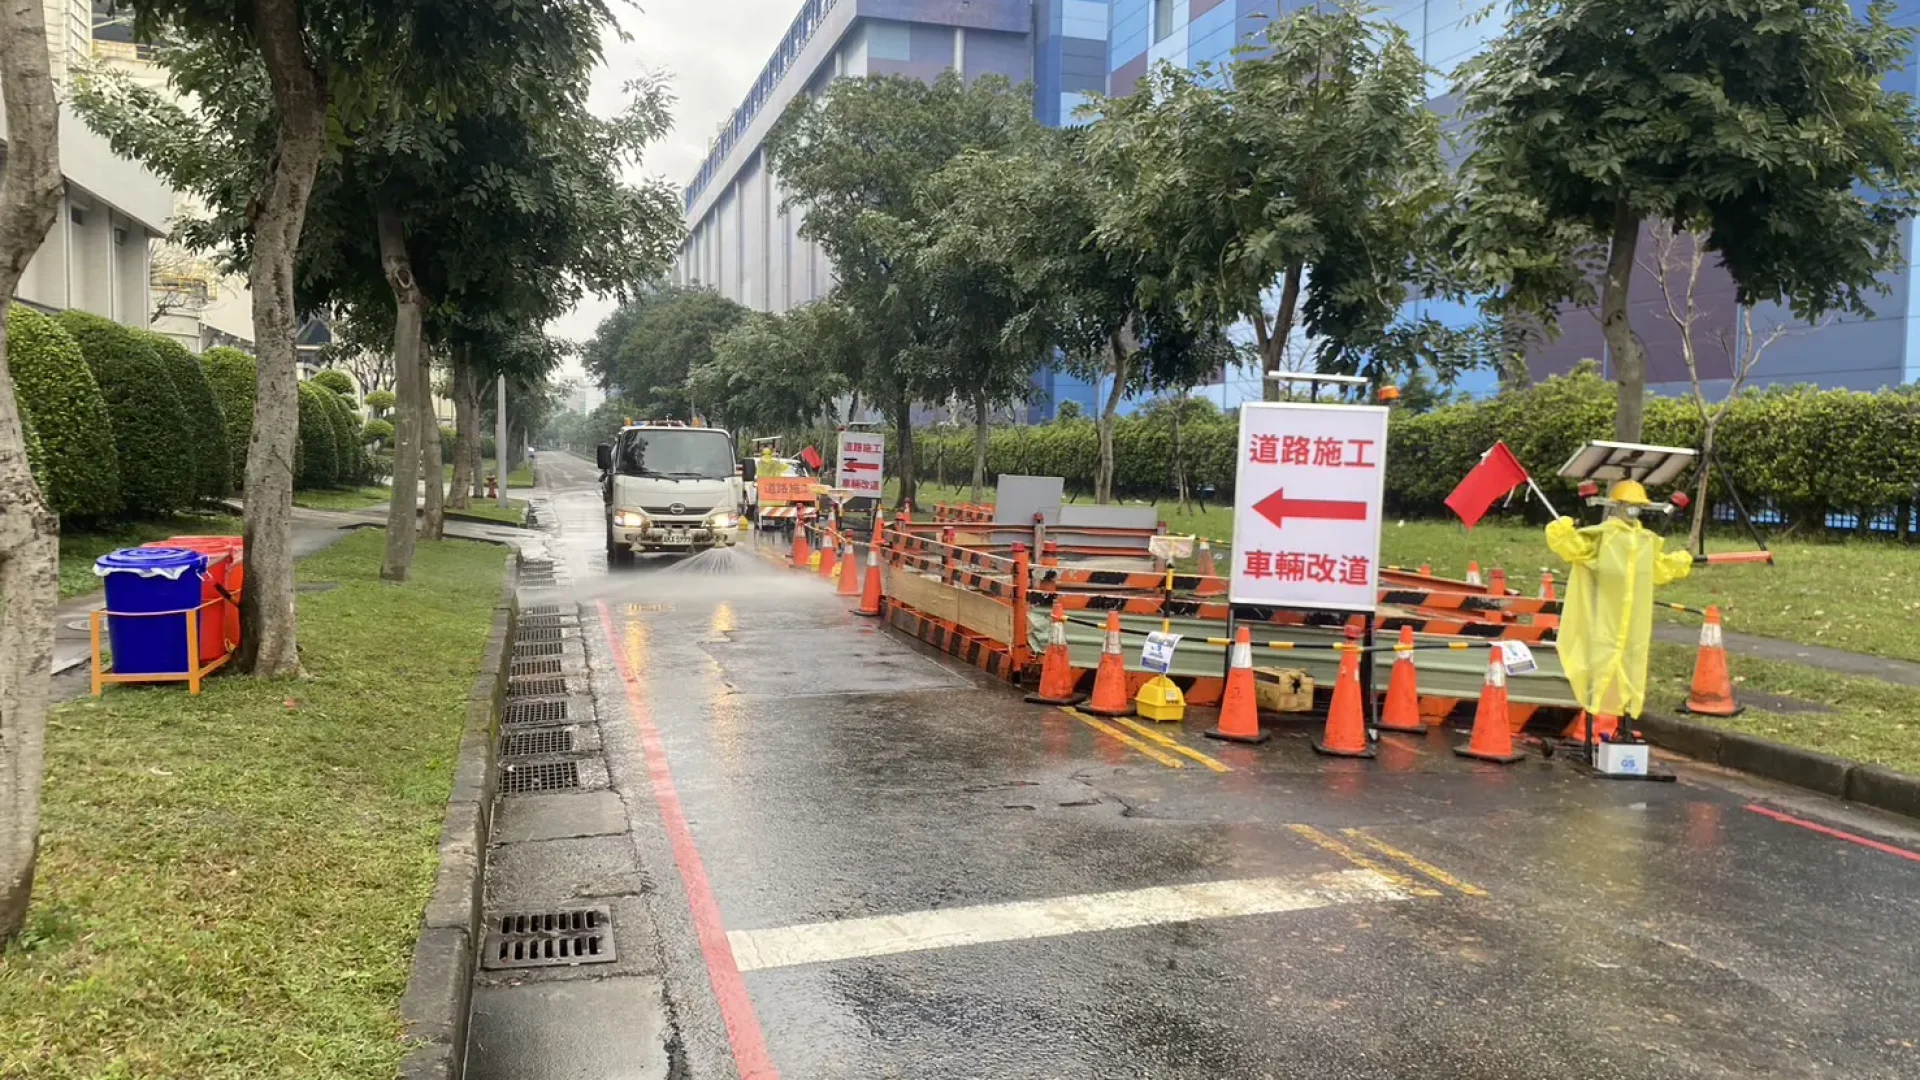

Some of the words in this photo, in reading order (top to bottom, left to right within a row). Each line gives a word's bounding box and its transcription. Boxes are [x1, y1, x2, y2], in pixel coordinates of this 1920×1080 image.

[1249, 434, 1375, 468] 道路施工
[1243, 549, 1369, 586] 車輛改道
